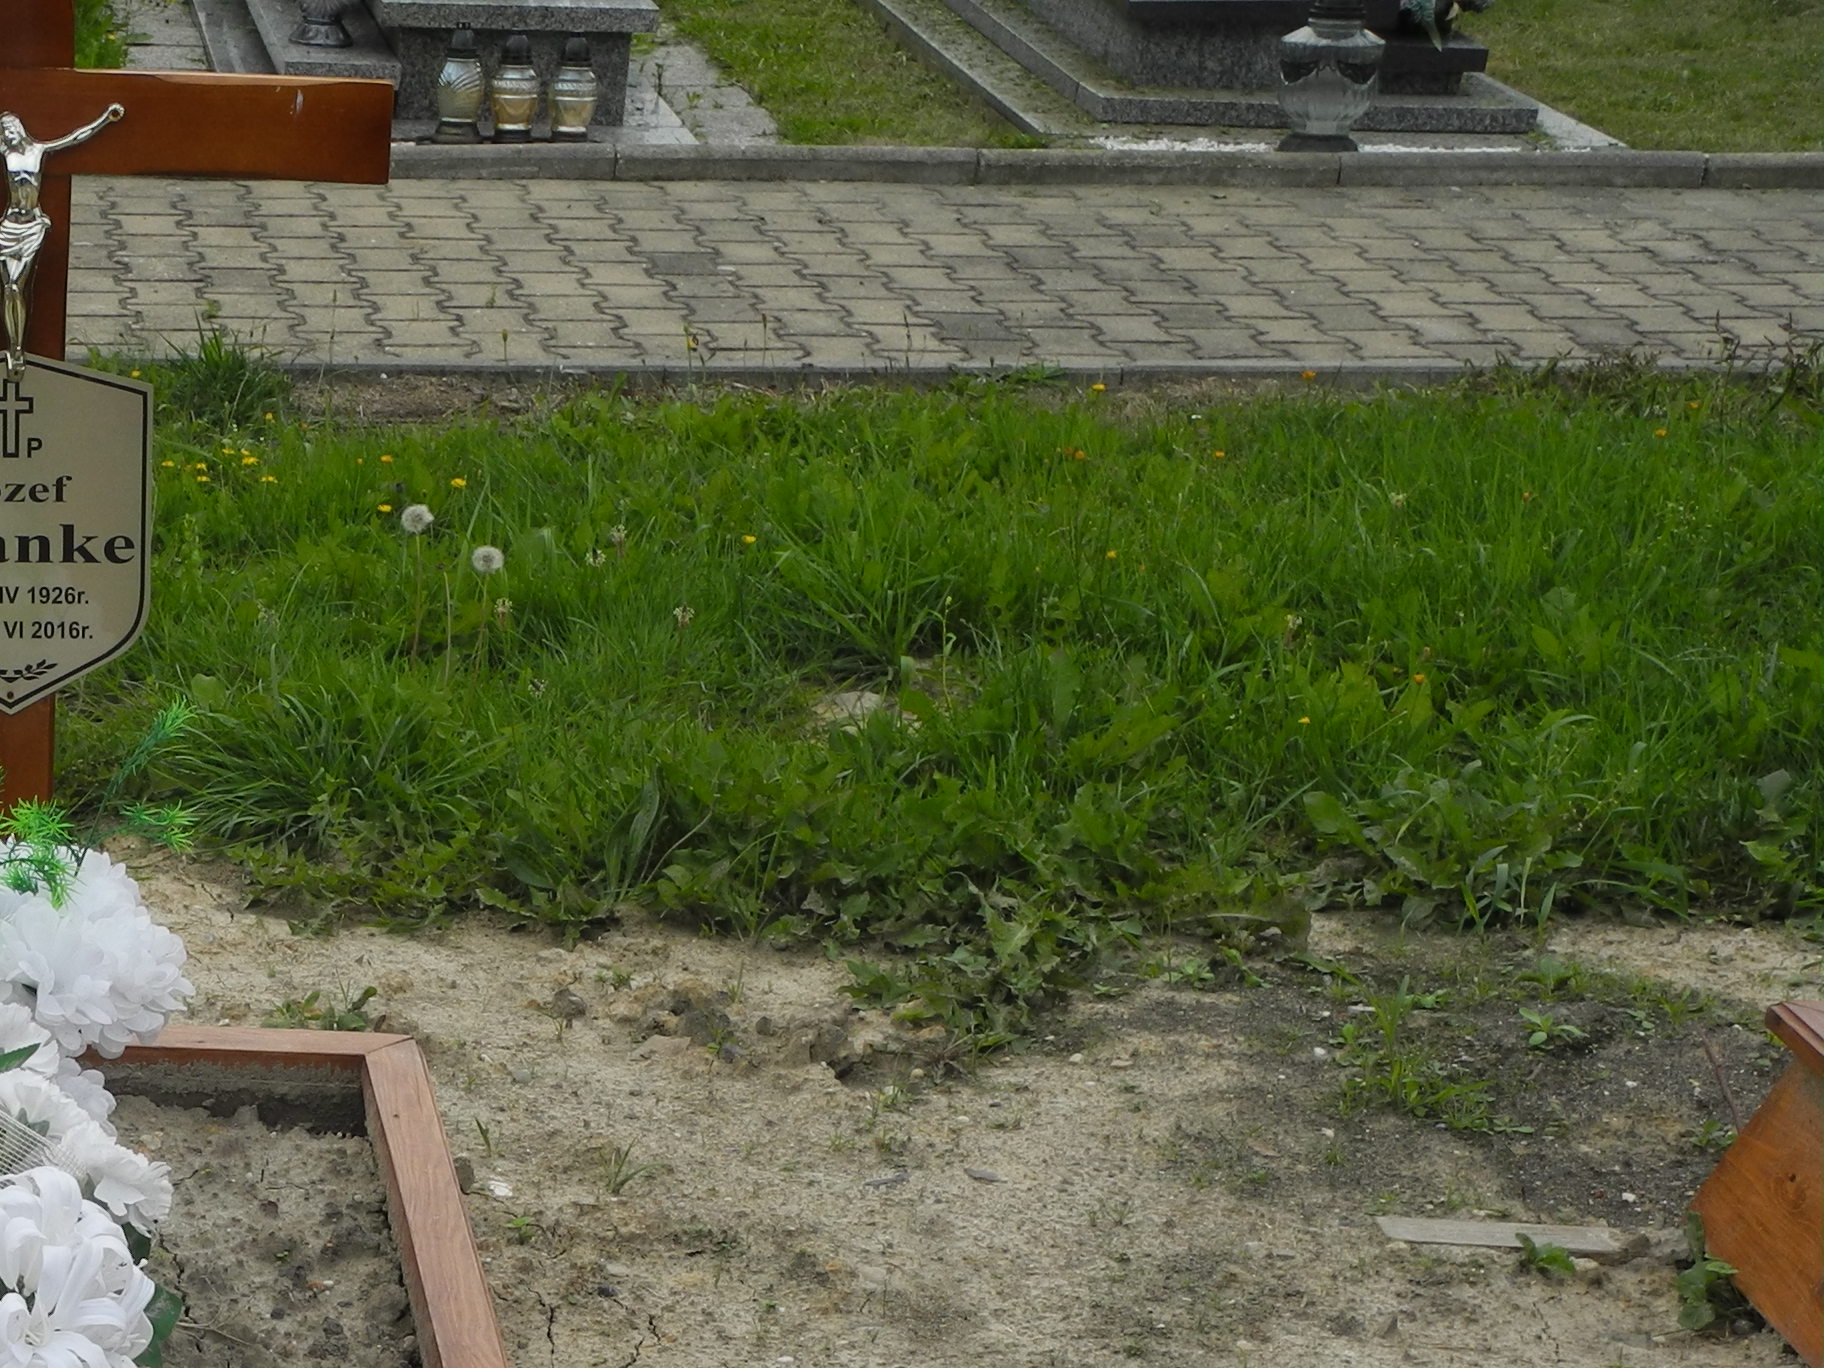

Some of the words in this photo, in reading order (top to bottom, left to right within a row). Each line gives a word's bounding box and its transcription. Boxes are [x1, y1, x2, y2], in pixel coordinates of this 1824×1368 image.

[26, 437, 43, 458] P
[0, 586, 20, 604] IV
[27, 586, 89, 605] 1926r.
[3, 620, 24, 639] VI
[31, 620, 93, 640] 2016r.
